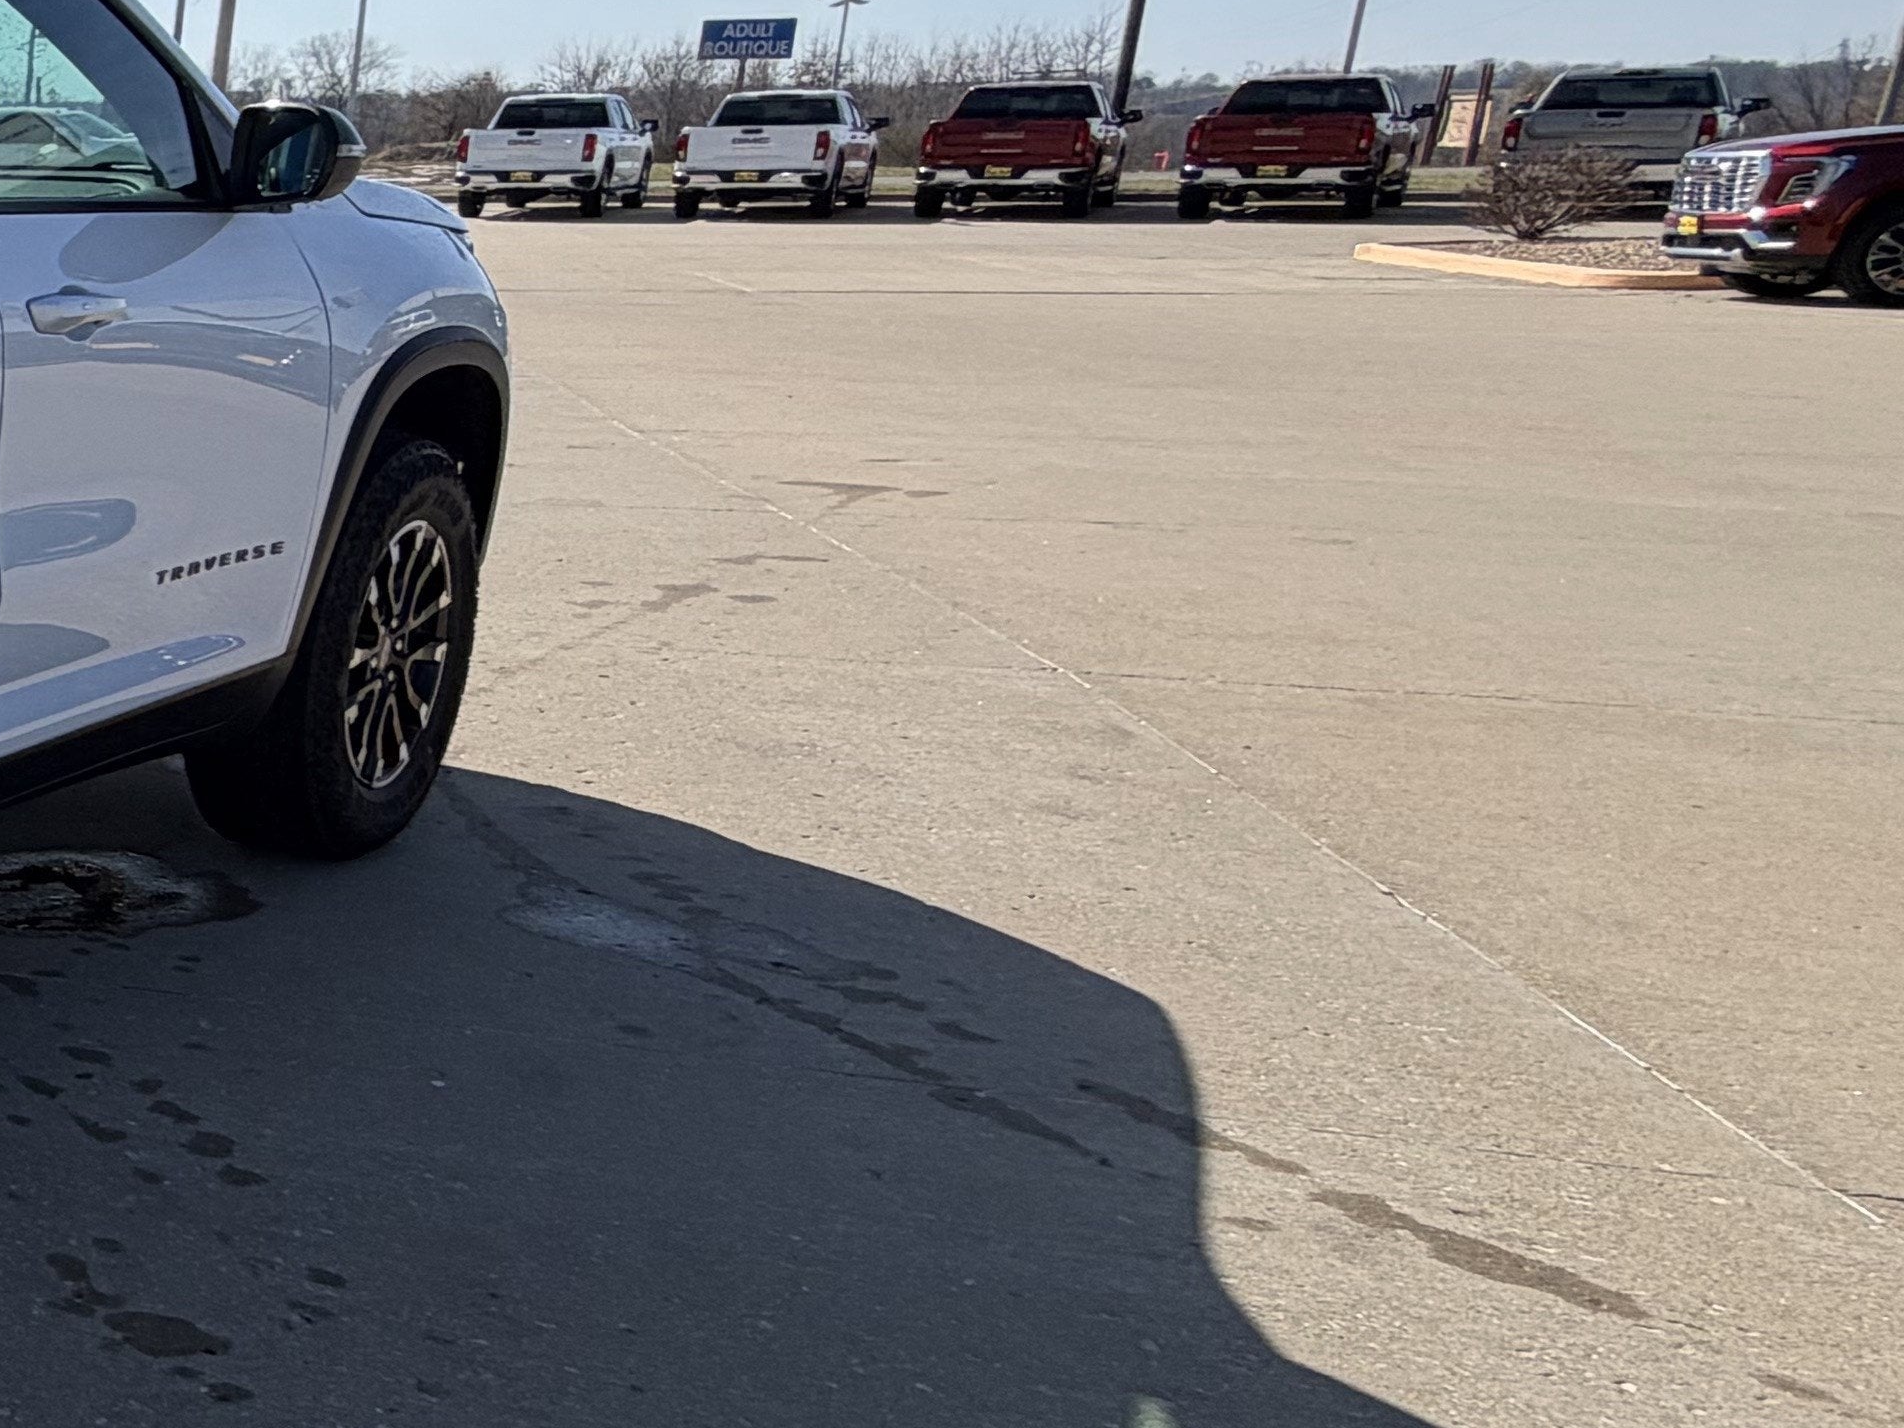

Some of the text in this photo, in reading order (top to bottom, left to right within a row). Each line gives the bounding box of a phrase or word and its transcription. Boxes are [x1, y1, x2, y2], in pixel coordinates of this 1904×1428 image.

[722, 22, 778, 39] ADULT
[701, 39, 790, 57] BOUTIQUE
[155, 540, 286, 586] TRAVERSE
